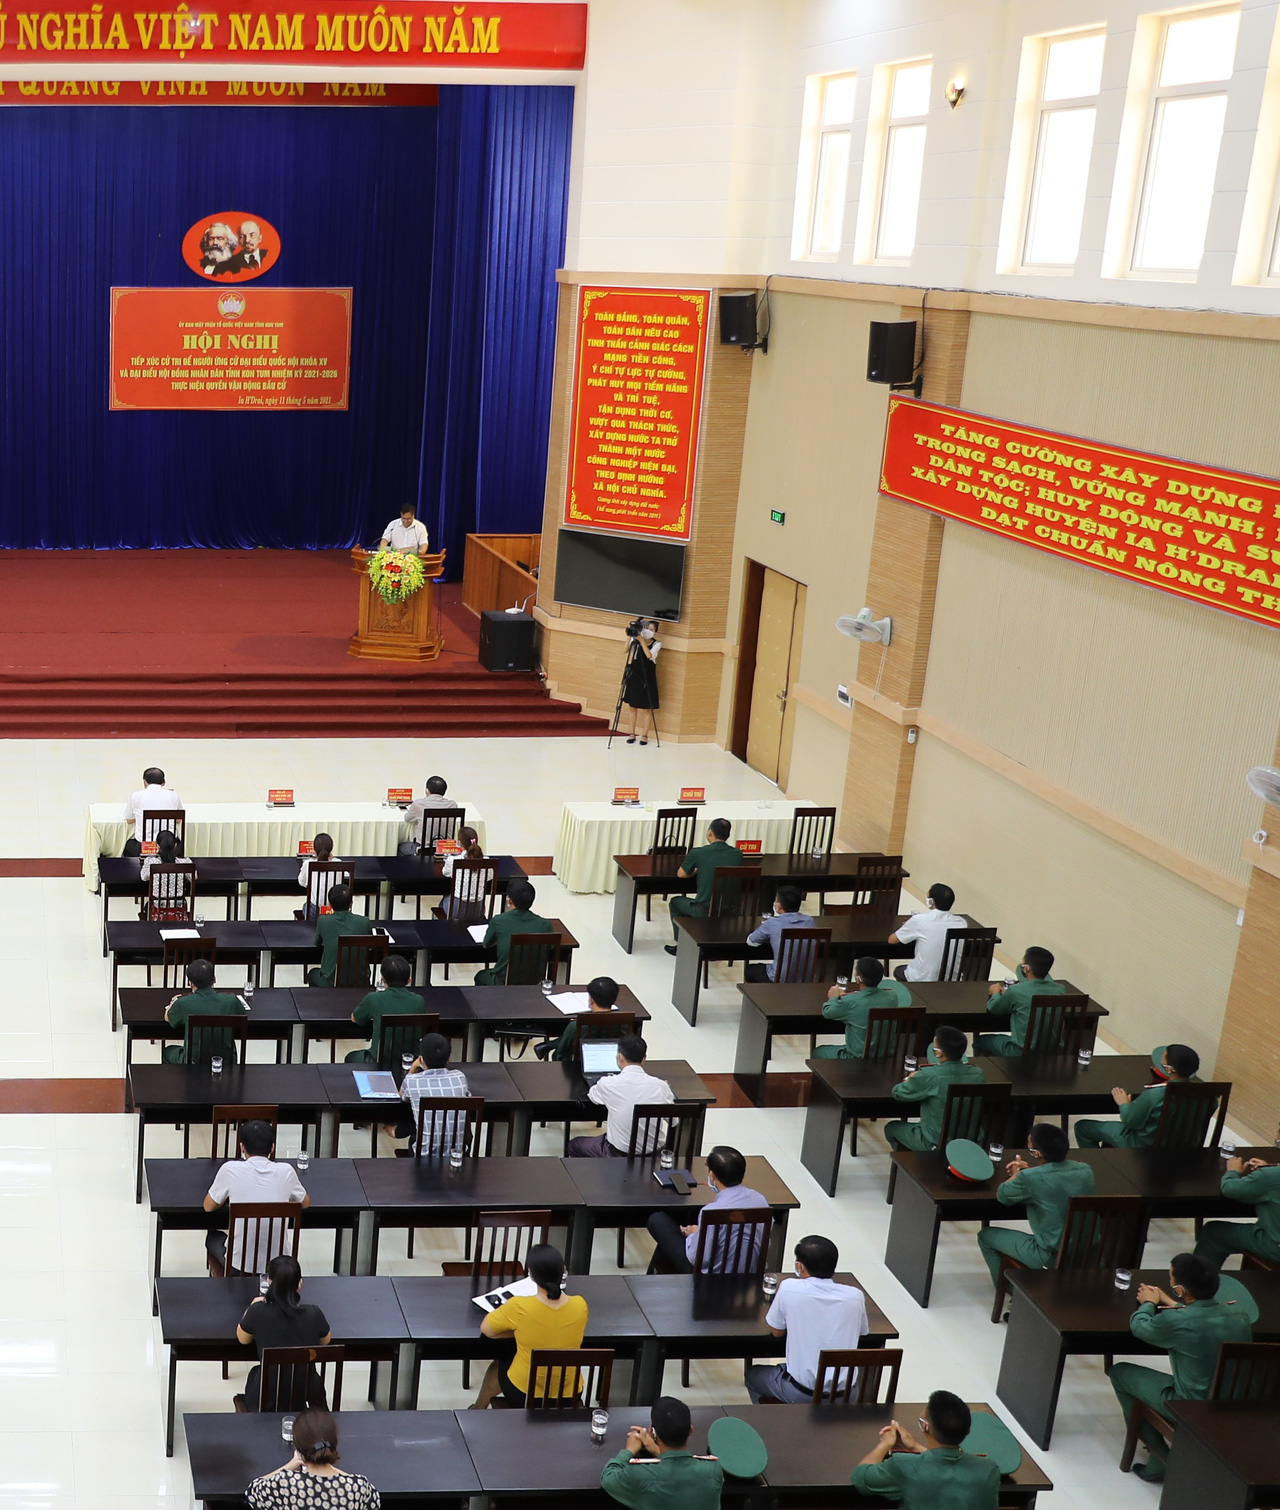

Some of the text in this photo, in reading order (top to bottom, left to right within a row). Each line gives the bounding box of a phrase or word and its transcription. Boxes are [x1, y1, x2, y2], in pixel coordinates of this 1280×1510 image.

[17, 4, 129, 50] NGHĨA
[134, 3, 219, 58] VIỆT
[228, 13, 305, 50] NAM
[315, 5, 413, 52] MUÔN
[423, 5, 502, 53] NĂM
[182, 330, 279, 354] HỘI NGHỊ
[602, 325, 680, 339] TOÀN DÂN NÊU CAO
[910, 466, 952, 487] XÂY
[955, 480, 1019, 510] DỰNG
[1024, 502, 1118, 540] HUYỆN
[1125, 531, 1156, 552] IA
[913, 433, 986, 463] TRONG
[991, 456, 1061, 487] SẠCH,
[1068, 476, 1146, 507] VỮNG
[1153, 497, 1265, 541] MẠNH;
[928, 454, 973, 477] DÂN
[978, 469, 1031, 497] TỘC;
[1036, 486, 1093, 512] HUY
[1098, 504, 1184, 538] ĐỘNG
[1192, 529, 1236, 553] VÀ
[940, 423, 1000, 449] TĂNG
[1005, 441, 1092, 473] CƯỜNG
[1098, 464, 1159, 488] XÂY
[1166, 479, 1263, 514] DỰNG
[980, 506, 1029, 530] ĐẠT
[1034, 524, 1127, 563] CHUẨN
[1134, 555, 1226, 594] NÔNG
